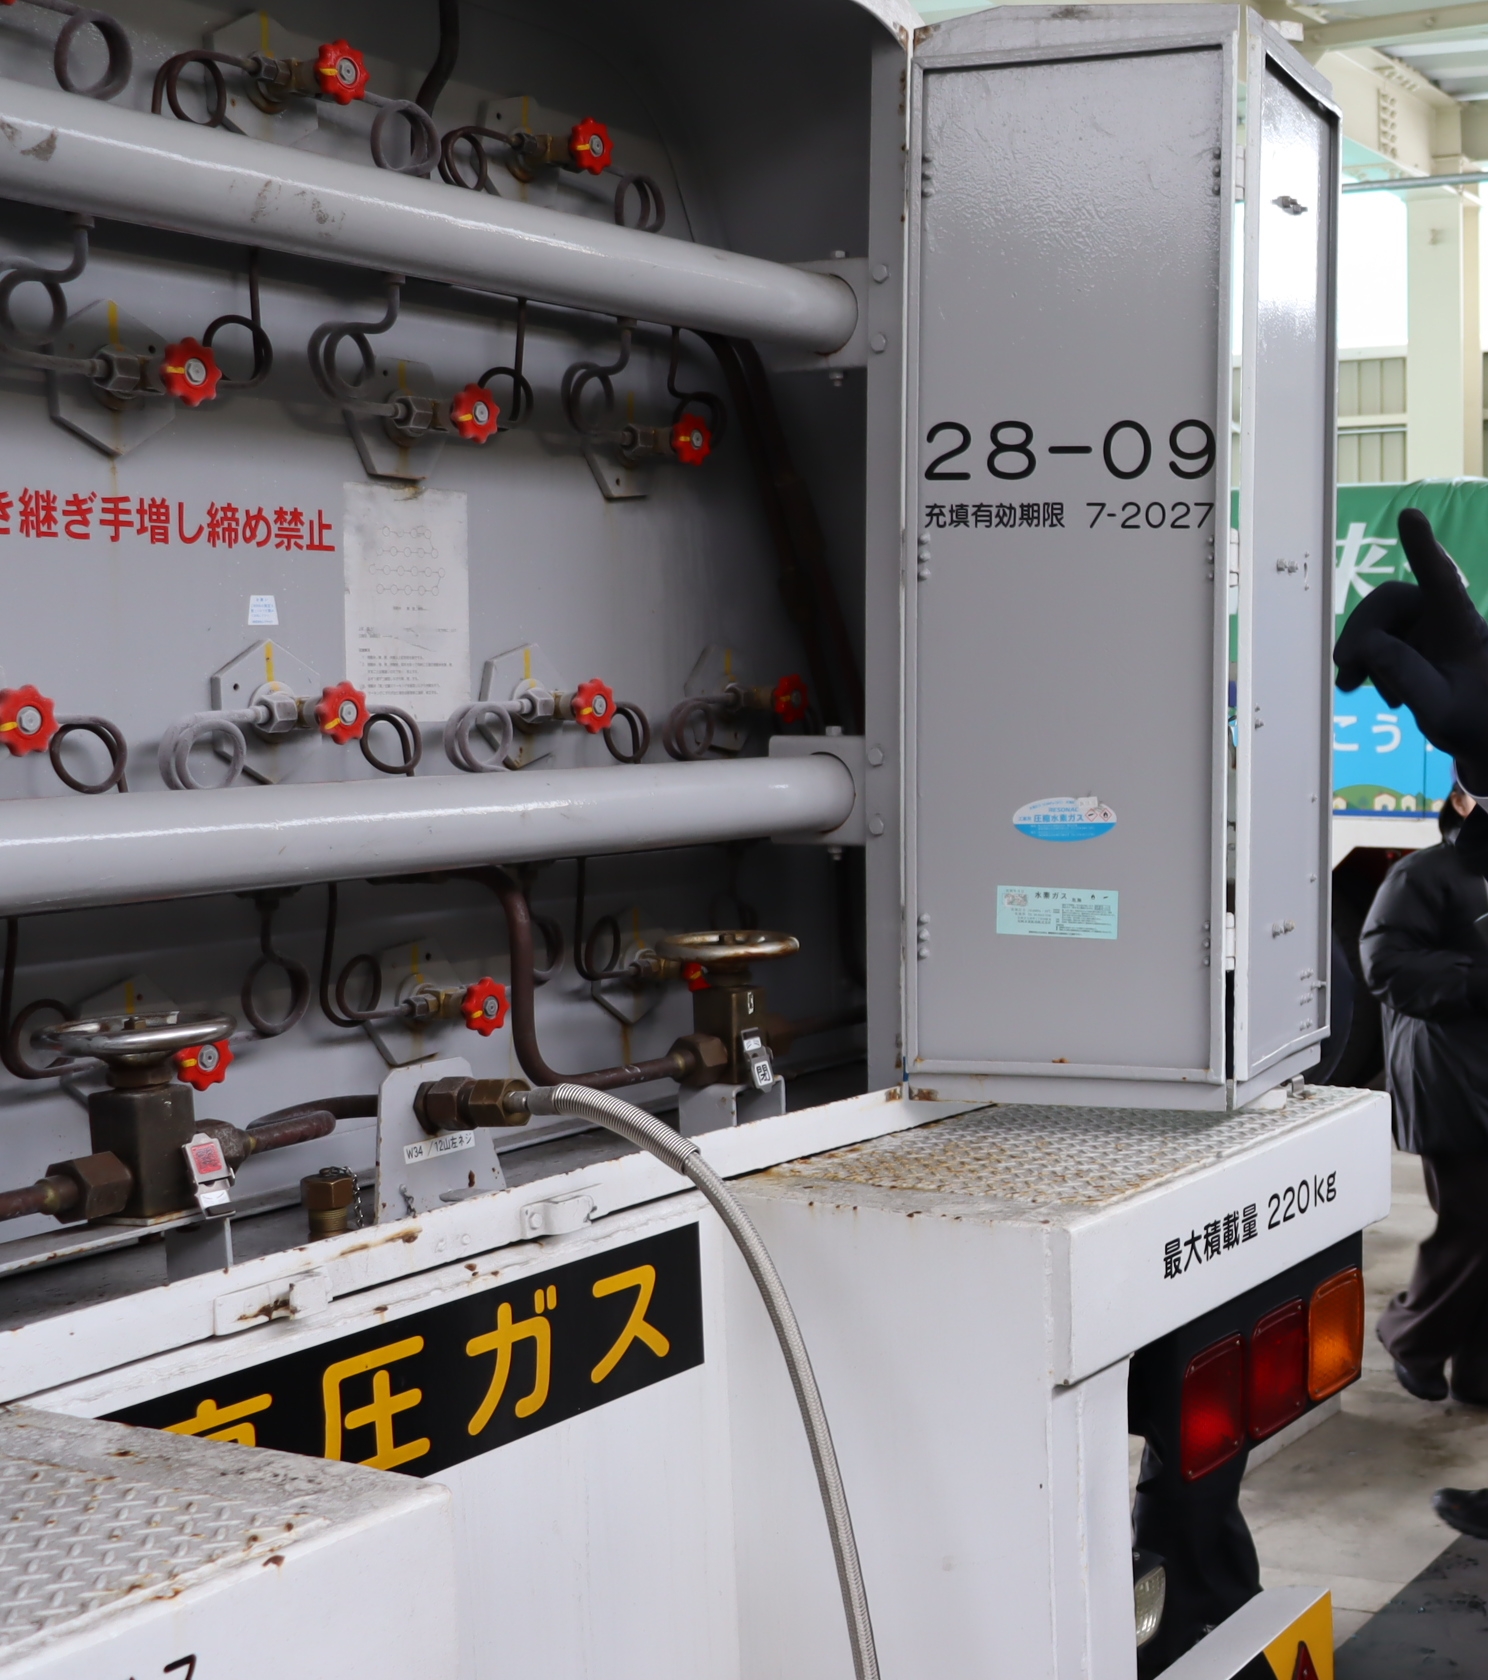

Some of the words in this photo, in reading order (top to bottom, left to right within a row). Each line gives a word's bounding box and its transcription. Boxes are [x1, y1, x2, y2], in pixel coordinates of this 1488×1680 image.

[924, 419, 1216, 480] 28-09
[924, 502, 1065, 529] 充填有効期限
[1086, 501, 1215, 529] 7-2027
[1163, 1202, 1259, 1280] 最大積載量
